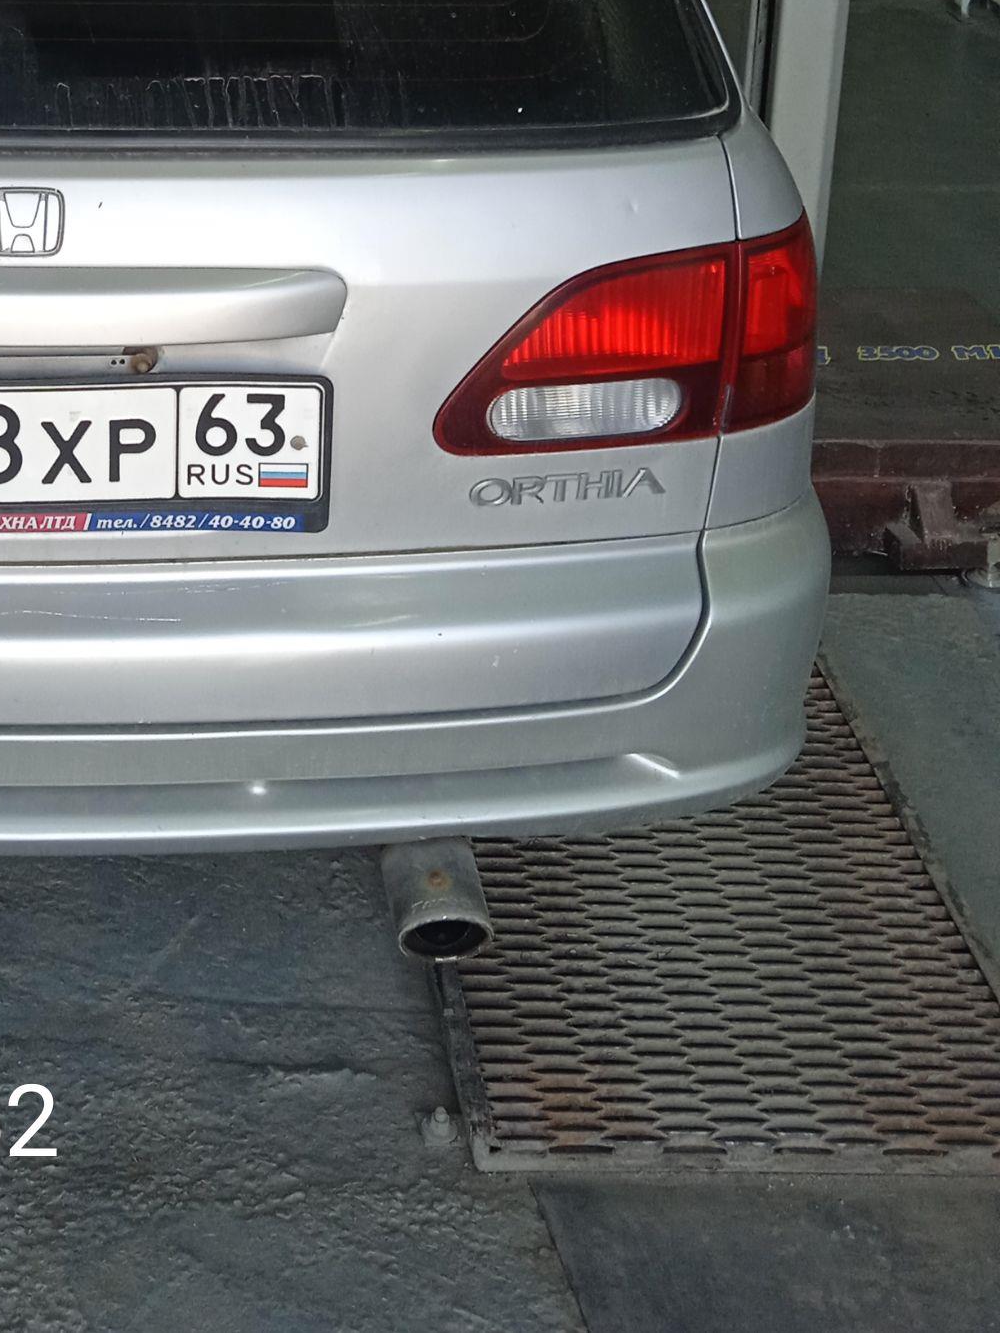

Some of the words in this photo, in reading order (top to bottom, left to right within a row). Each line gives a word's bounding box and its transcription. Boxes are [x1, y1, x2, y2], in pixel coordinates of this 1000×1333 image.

[195, 394, 286, 456] 63
[186, 463, 254, 486] RUS
[468, 467, 666, 507] ORTHIA
